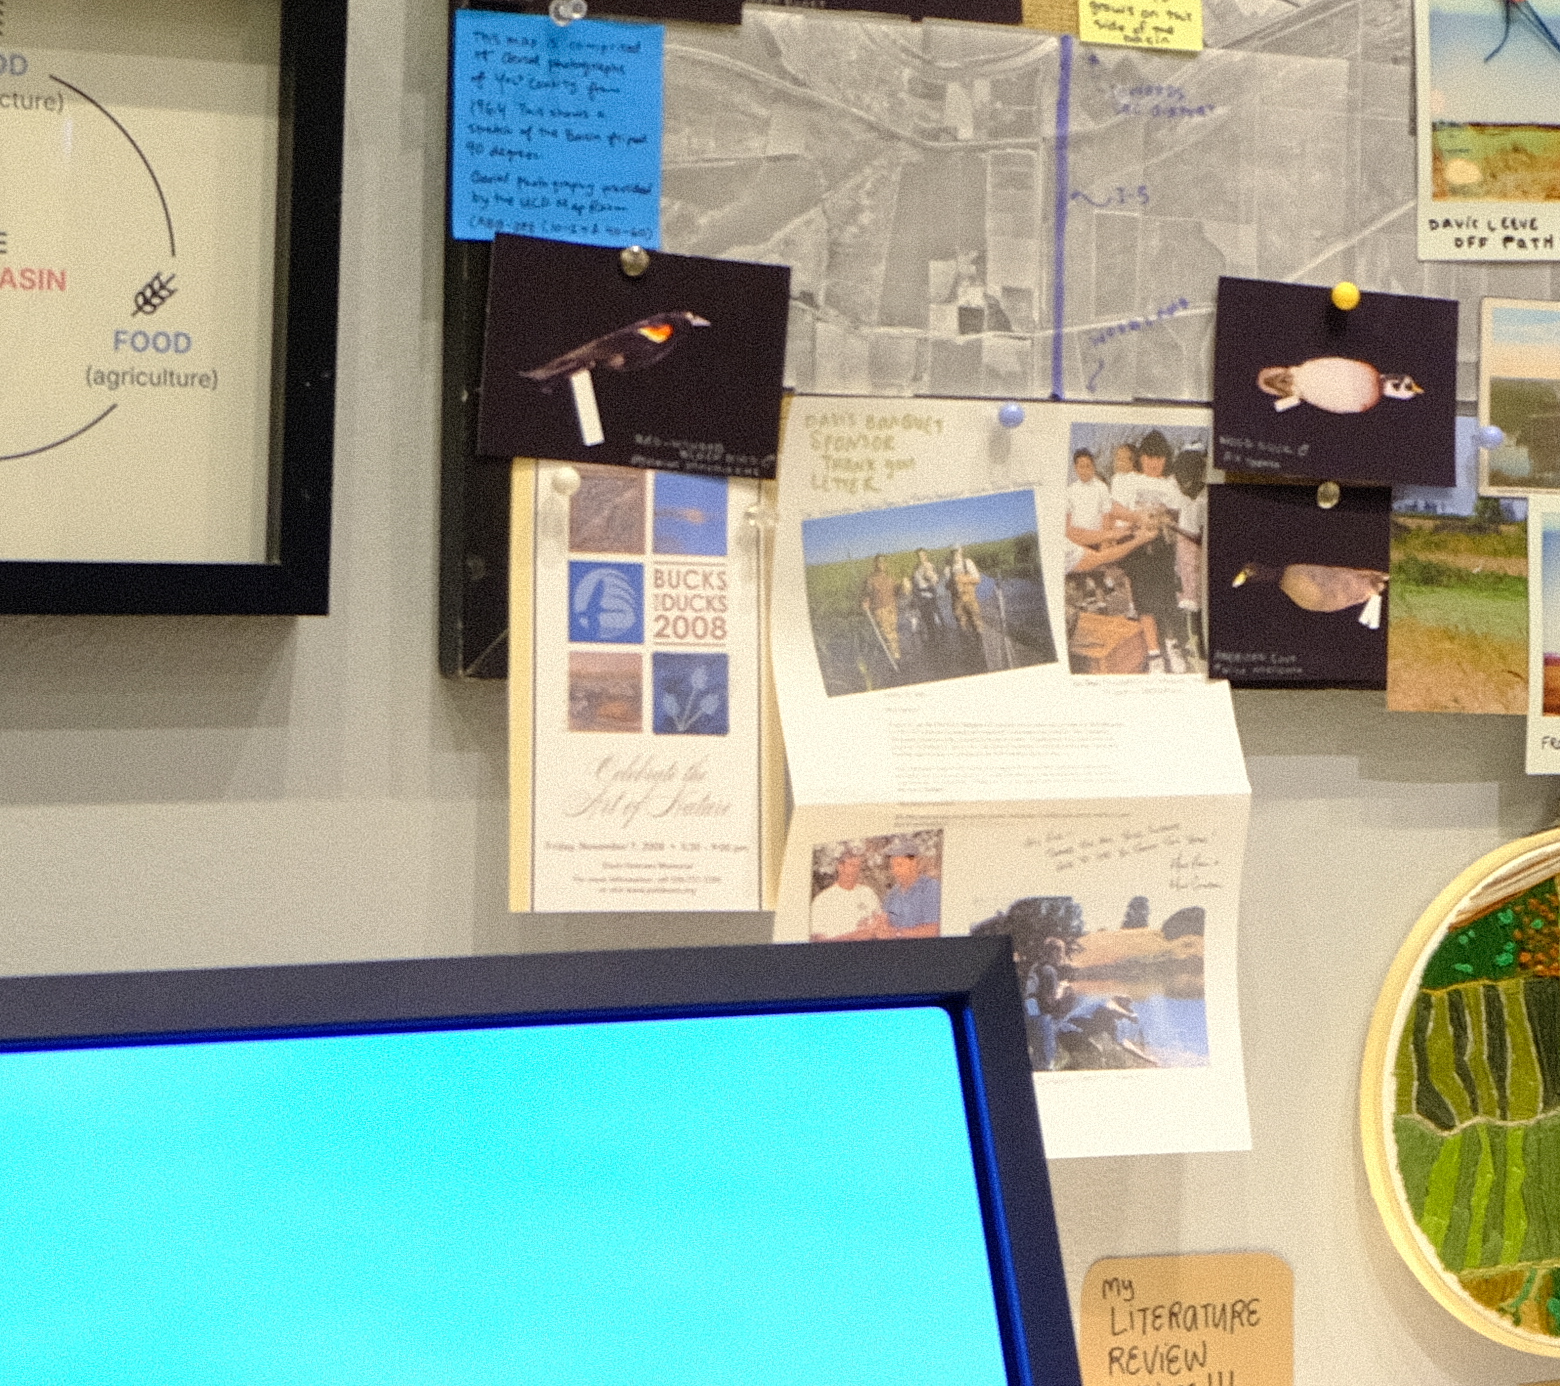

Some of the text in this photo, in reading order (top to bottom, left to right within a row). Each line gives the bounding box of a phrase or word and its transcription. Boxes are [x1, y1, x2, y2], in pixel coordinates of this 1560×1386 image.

[113, 329, 193, 356] FOOD
[84, 364, 219, 393] (agriculture)
[652, 569, 728, 591] BUCKS
[668, 593, 728, 613] DUCKS
[652, 615, 728, 641] 2008
[1110, 1297, 1262, 1337] LITERATURE
[1107, 1340, 1208, 1376] REVIEW
